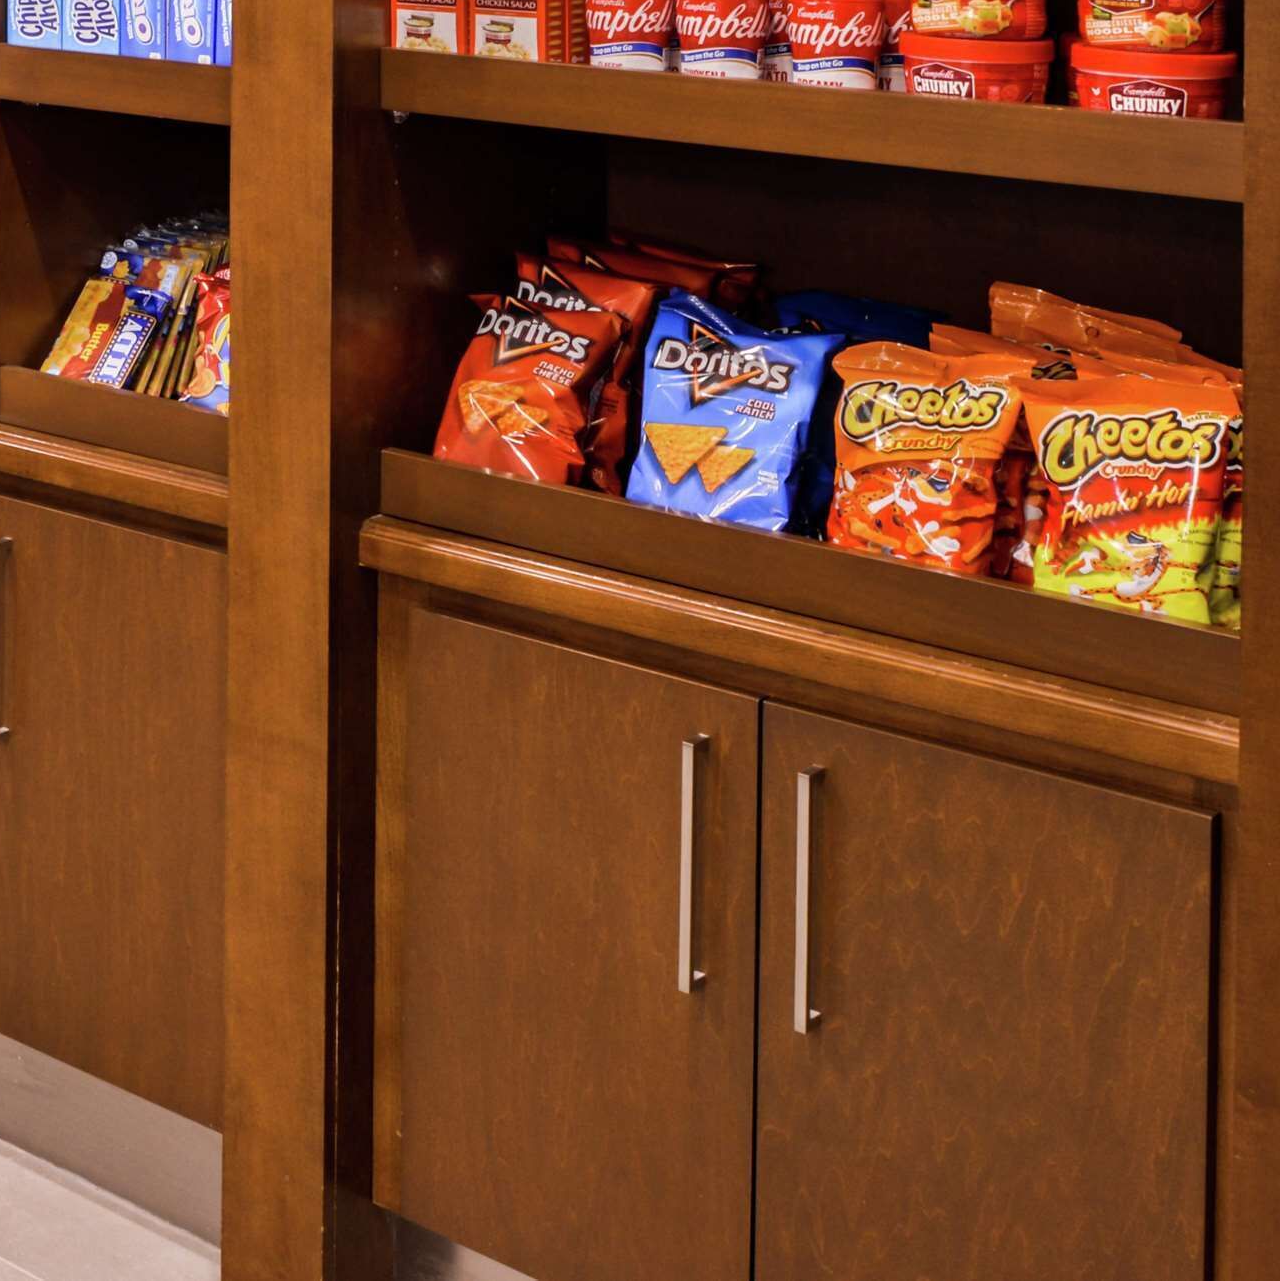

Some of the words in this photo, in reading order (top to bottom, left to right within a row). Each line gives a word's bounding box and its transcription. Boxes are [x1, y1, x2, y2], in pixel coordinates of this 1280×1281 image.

[510, 0, 536, 9] SALAD
[586, 0, 672, 39] ampbell
[676, 3, 768, 45] ampbell
[788, 12, 881, 54] ampbell
[914, 75, 969, 96] CHUNKY
[1111, 93, 1181, 115] CHUNKY
[80, 323, 109, 361] Butter
[476, 309, 590, 359] Doritos
[532, 367, 572, 386] CHEESE
[539, 361, 576, 379] NACHO
[656, 339, 789, 390] Doritos
[735, 405, 775, 419] RANCH
[746, 399, 776, 411] COOL
[843, 382, 1002, 439] Cheetos
[1043, 411, 1220, 485] Cheetos
[1101, 462, 1163, 478] Crunchy
[1145, 480, 1192, 507] Hot
